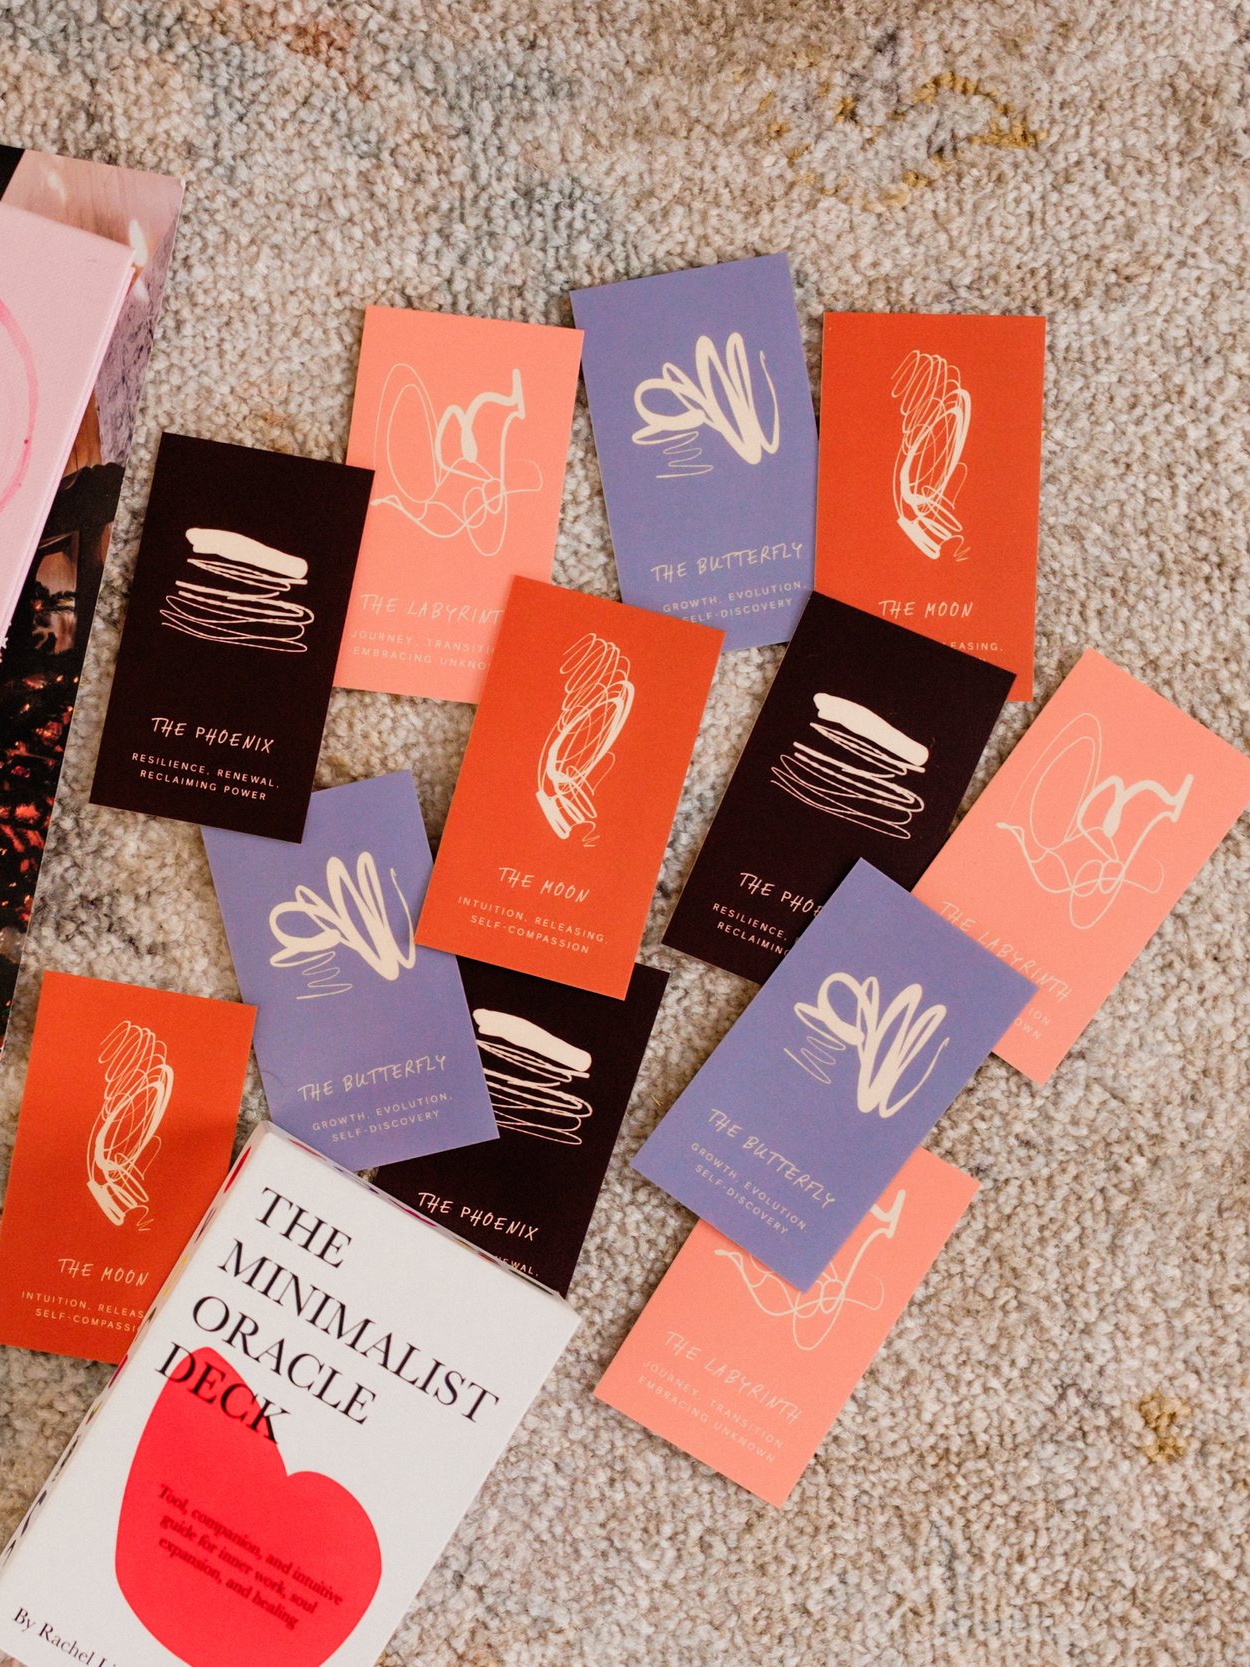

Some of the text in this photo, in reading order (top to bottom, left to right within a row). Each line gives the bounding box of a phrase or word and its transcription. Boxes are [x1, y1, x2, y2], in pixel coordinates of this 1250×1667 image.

[650, 542, 803, 583] THE BUTTERFLY
[360, 593, 505, 626] THE LABYRINT
[878, 599, 974, 619] THE MOON
[353, 646, 488, 671] EMBRACING UNKNO
[426, 638, 495, 654] TRANSITI
[151, 717, 274, 754] THE PHOENIX
[139, 769, 267, 801] RECLAIMING POWER
[499, 867, 590, 904] THE MOON
[740, 872, 823, 918] THE PHOE
[470, 915, 590, 954] SELF-COMPASSION
[716, 921, 789, 957] RECLAIMIN
[940, 900, 1072, 1003] THE LABYRINTH
[297, 1054, 446, 1102] THE BUTTERFLY
[332, 1110, 440, 1142] SELF-DISCOVERY
[708, 1108, 836, 1209] THE BUTTERFLY
[418, 1192, 539, 1242] THE PHOENIX
[695, 1164, 789, 1235] SELF-DISCOVERY
[255, 1187, 352, 1269] THE
[58, 1258, 149, 1287] THE MOON
[35, 1308, 139, 1333] SELF-COMPASSI
[98, 1303, 144, 1319] RELEAS
[217, 1238, 500, 1423] MINIMALIST
[192, 1295, 377, 1425] ORACLE
[664, 1331, 802, 1425] THE LABYRINTH
[155, 1342, 291, 1444] DECK
[638, 1376, 775, 1464] EMBRACING UNKNOWN
[709, 1398, 783, 1449] TRANSITION
[158, 1483, 343, 1606] Tool, companion, and intuitive
[160, 1515, 318, 1614] guide for inner work, soul
[158, 1537, 299, 1631] expansion, and healing
[13, 1607, 95, 1666] By Rachel
